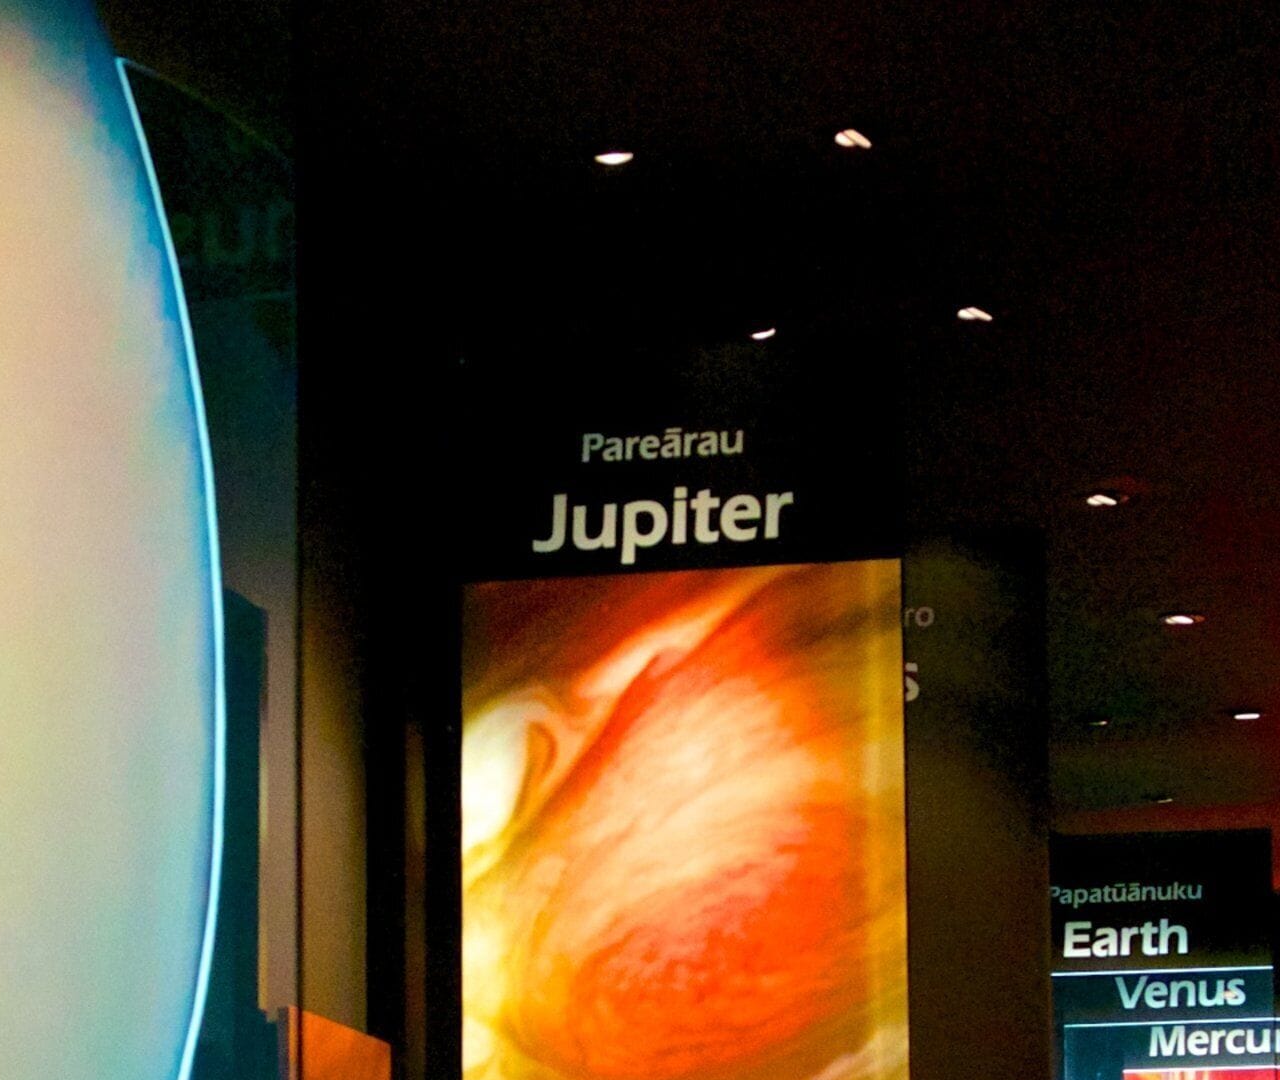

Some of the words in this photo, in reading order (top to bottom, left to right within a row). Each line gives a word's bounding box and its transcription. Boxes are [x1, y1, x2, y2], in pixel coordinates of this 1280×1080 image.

[581, 427, 744, 463] Pareārau
[532, 486, 794, 564] Jupiter
[1062, 918, 1189, 958] Earth
[1115, 976, 1246, 1009] Venus
